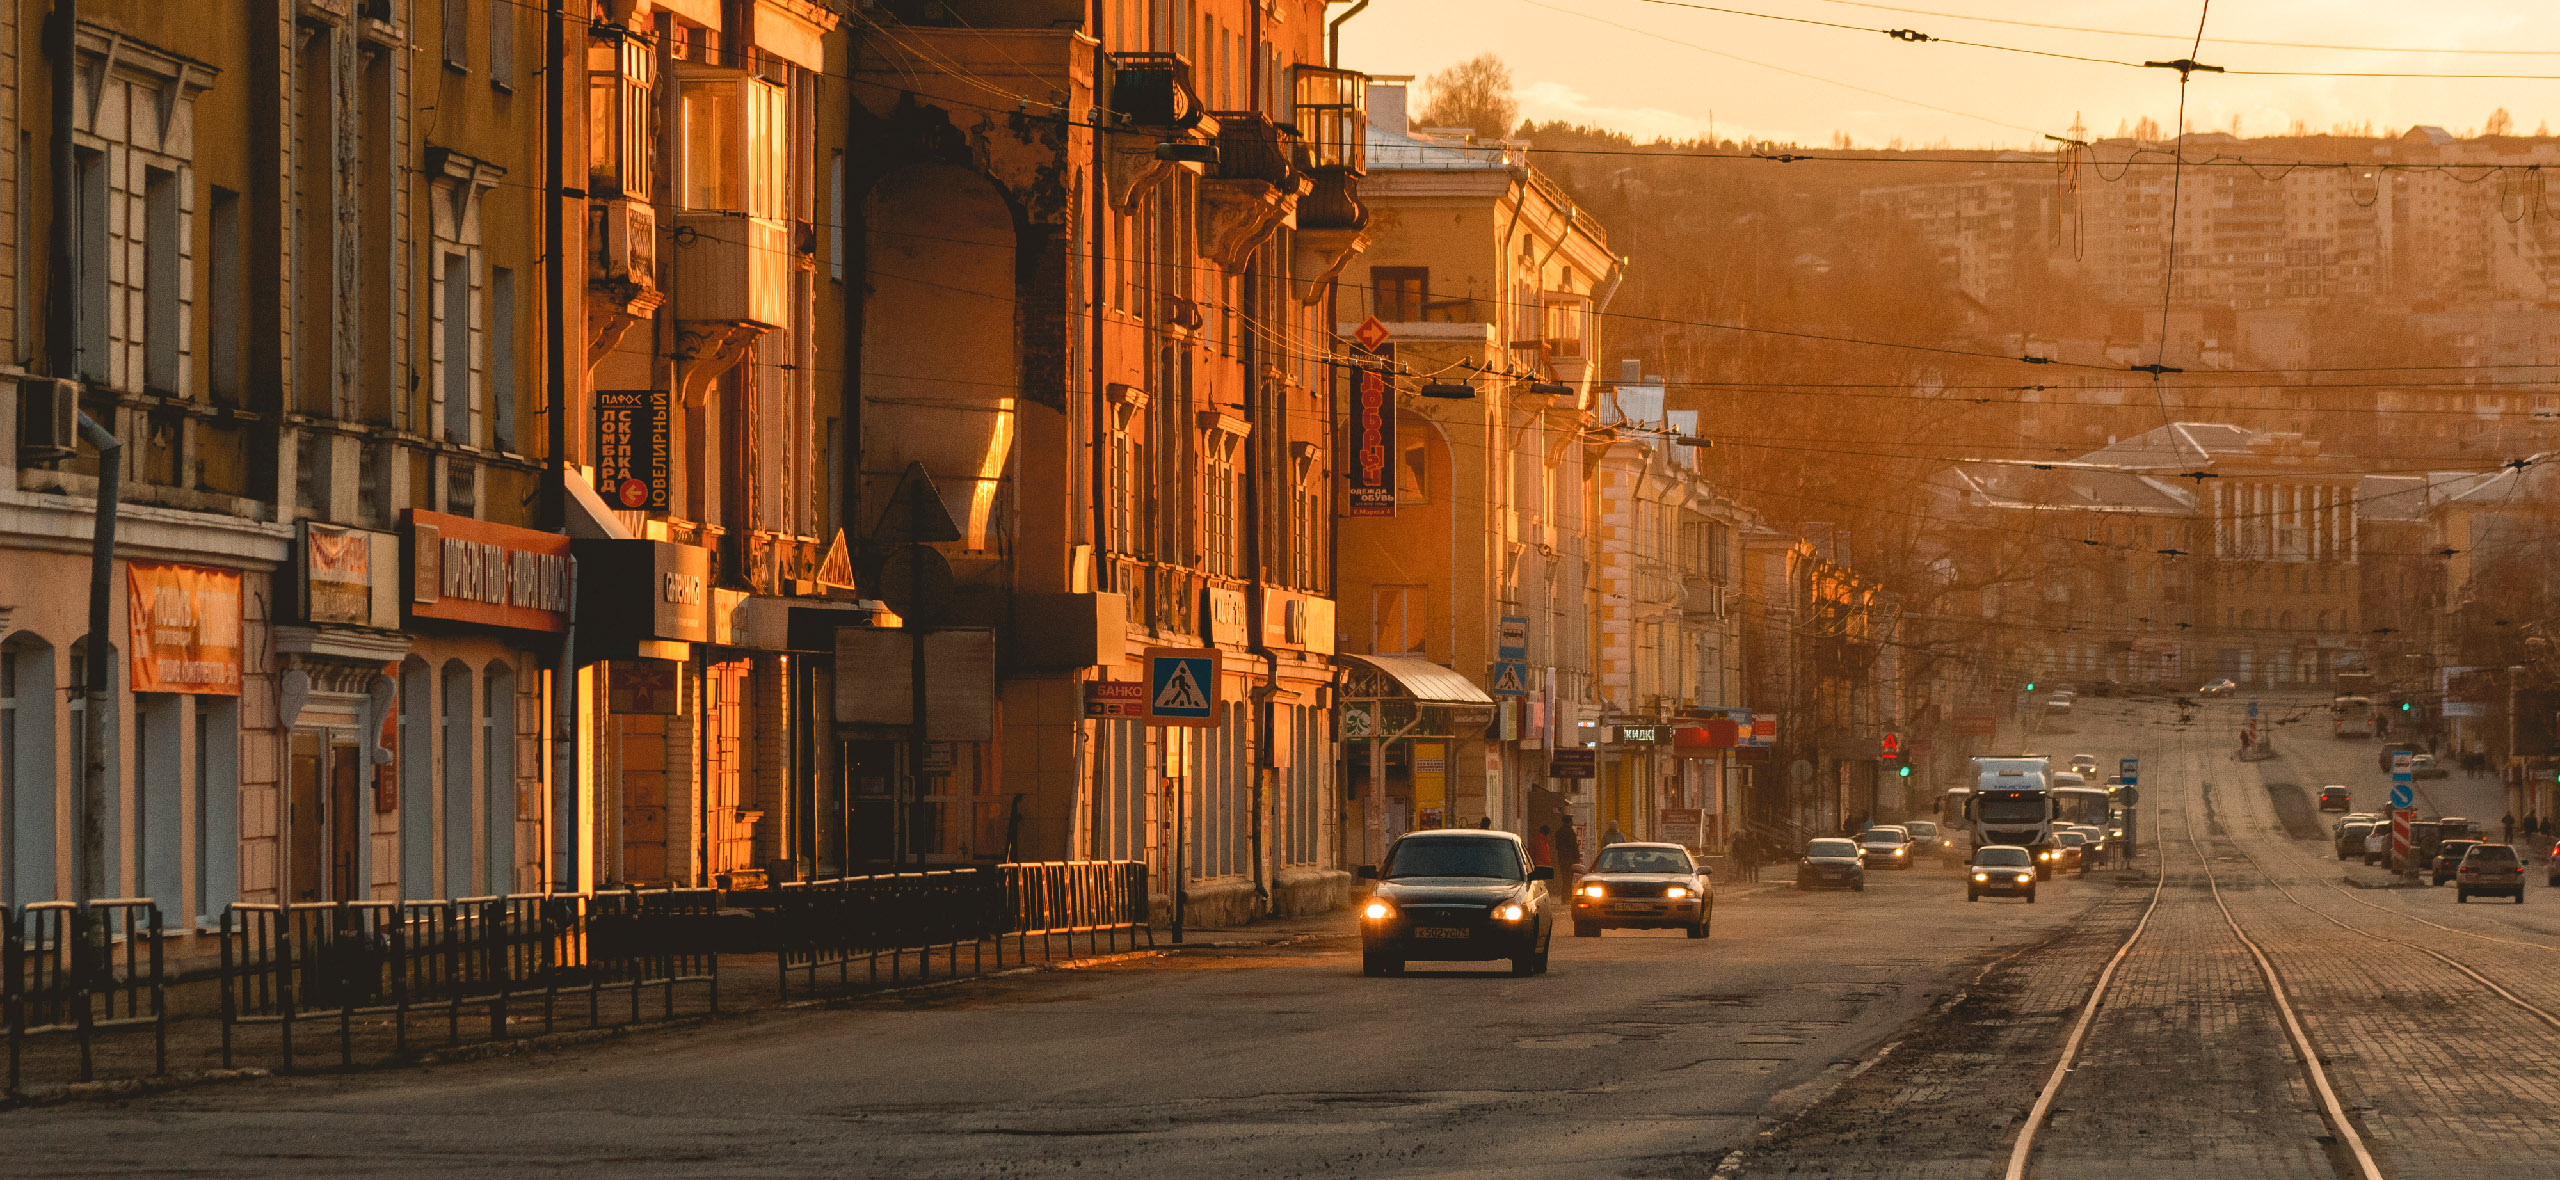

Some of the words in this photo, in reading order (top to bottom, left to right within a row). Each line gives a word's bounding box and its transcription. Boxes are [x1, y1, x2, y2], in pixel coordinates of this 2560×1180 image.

[601, 394, 642, 405] ПАФОС
[601, 410, 617, 493] ЛОМБАРД
[617, 410, 632, 480] СКУПКА
[650, 393, 667, 507] ЮВЕЛИРНЫЙ
[1361, 492, 1394, 501] ОБУВЬ
